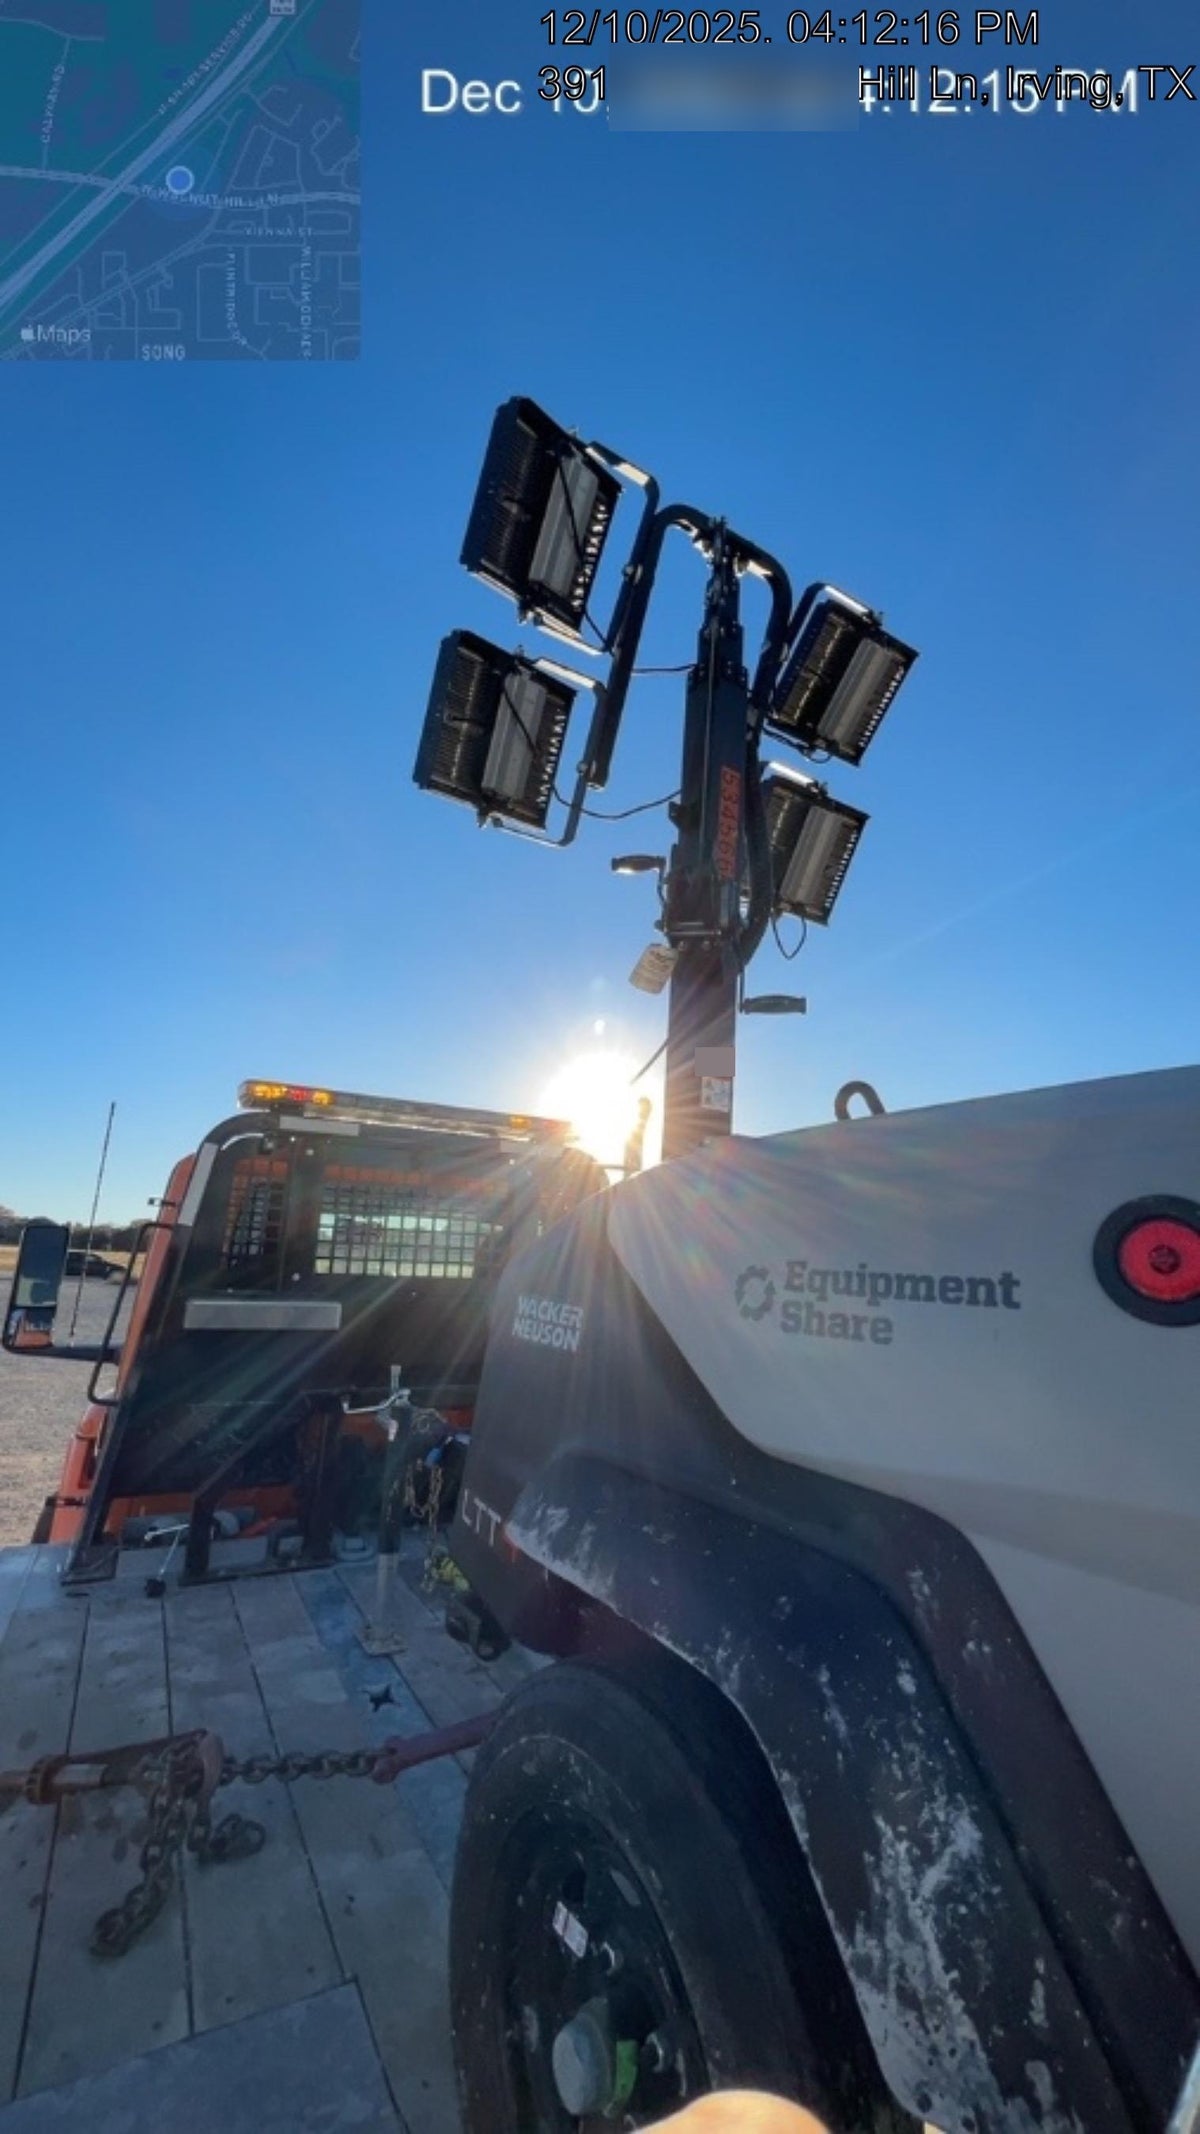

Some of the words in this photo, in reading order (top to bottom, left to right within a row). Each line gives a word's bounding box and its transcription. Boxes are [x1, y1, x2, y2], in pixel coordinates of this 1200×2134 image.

[784, 1260, 1021, 1310] Equipment
[518, 1295, 585, 1329] WACKER
[779, 1301, 893, 1345] Share
[511, 1316, 580, 1352] NEUSON
